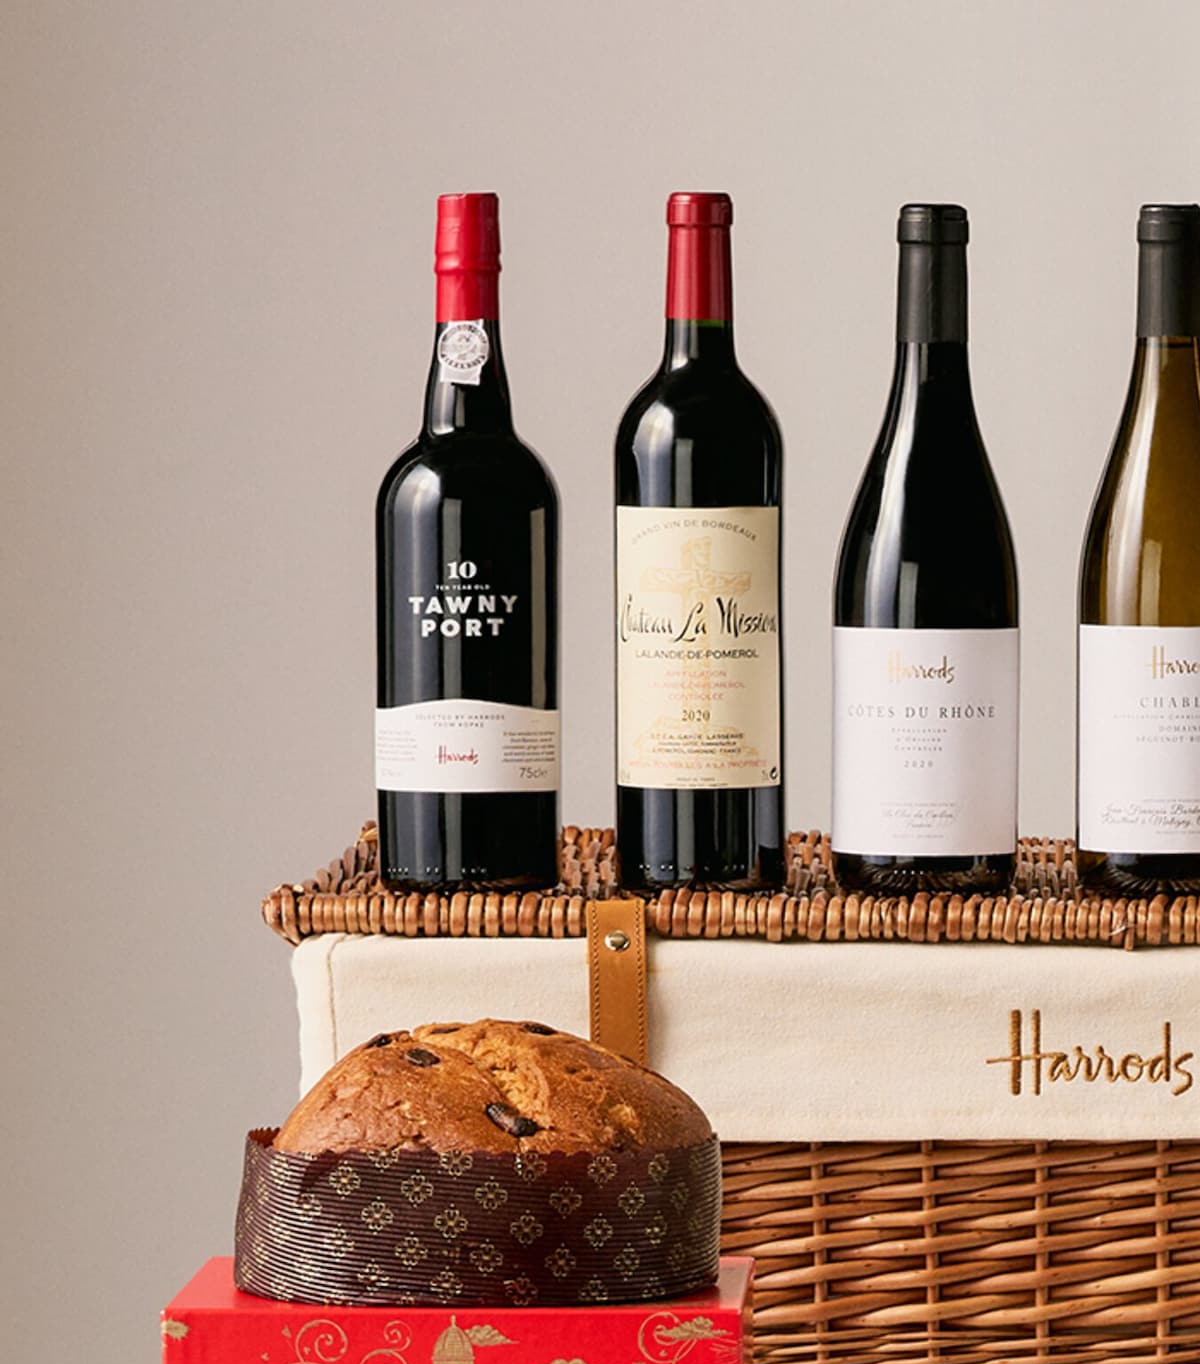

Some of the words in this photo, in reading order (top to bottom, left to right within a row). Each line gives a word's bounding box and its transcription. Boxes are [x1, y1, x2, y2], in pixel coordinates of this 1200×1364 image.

[684, 519, 698, 528] DE
[702, 519, 757, 541] BORDEAUX
[447, 561, 477, 579] 10
[408, 595, 518, 615] TAWNY
[421, 618, 504, 637] PORT
[674, 601, 707, 642] La
[888, 650, 955, 684] Harrods
[682, 710, 710, 721] 2020
[848, 704, 895, 718] CÔTES
[905, 706, 928, 718] DU
[939, 704, 995, 719] RHÔNE
[436, 745, 479, 765] Harrods
[986, 1008, 1193, 1096] Harrods
